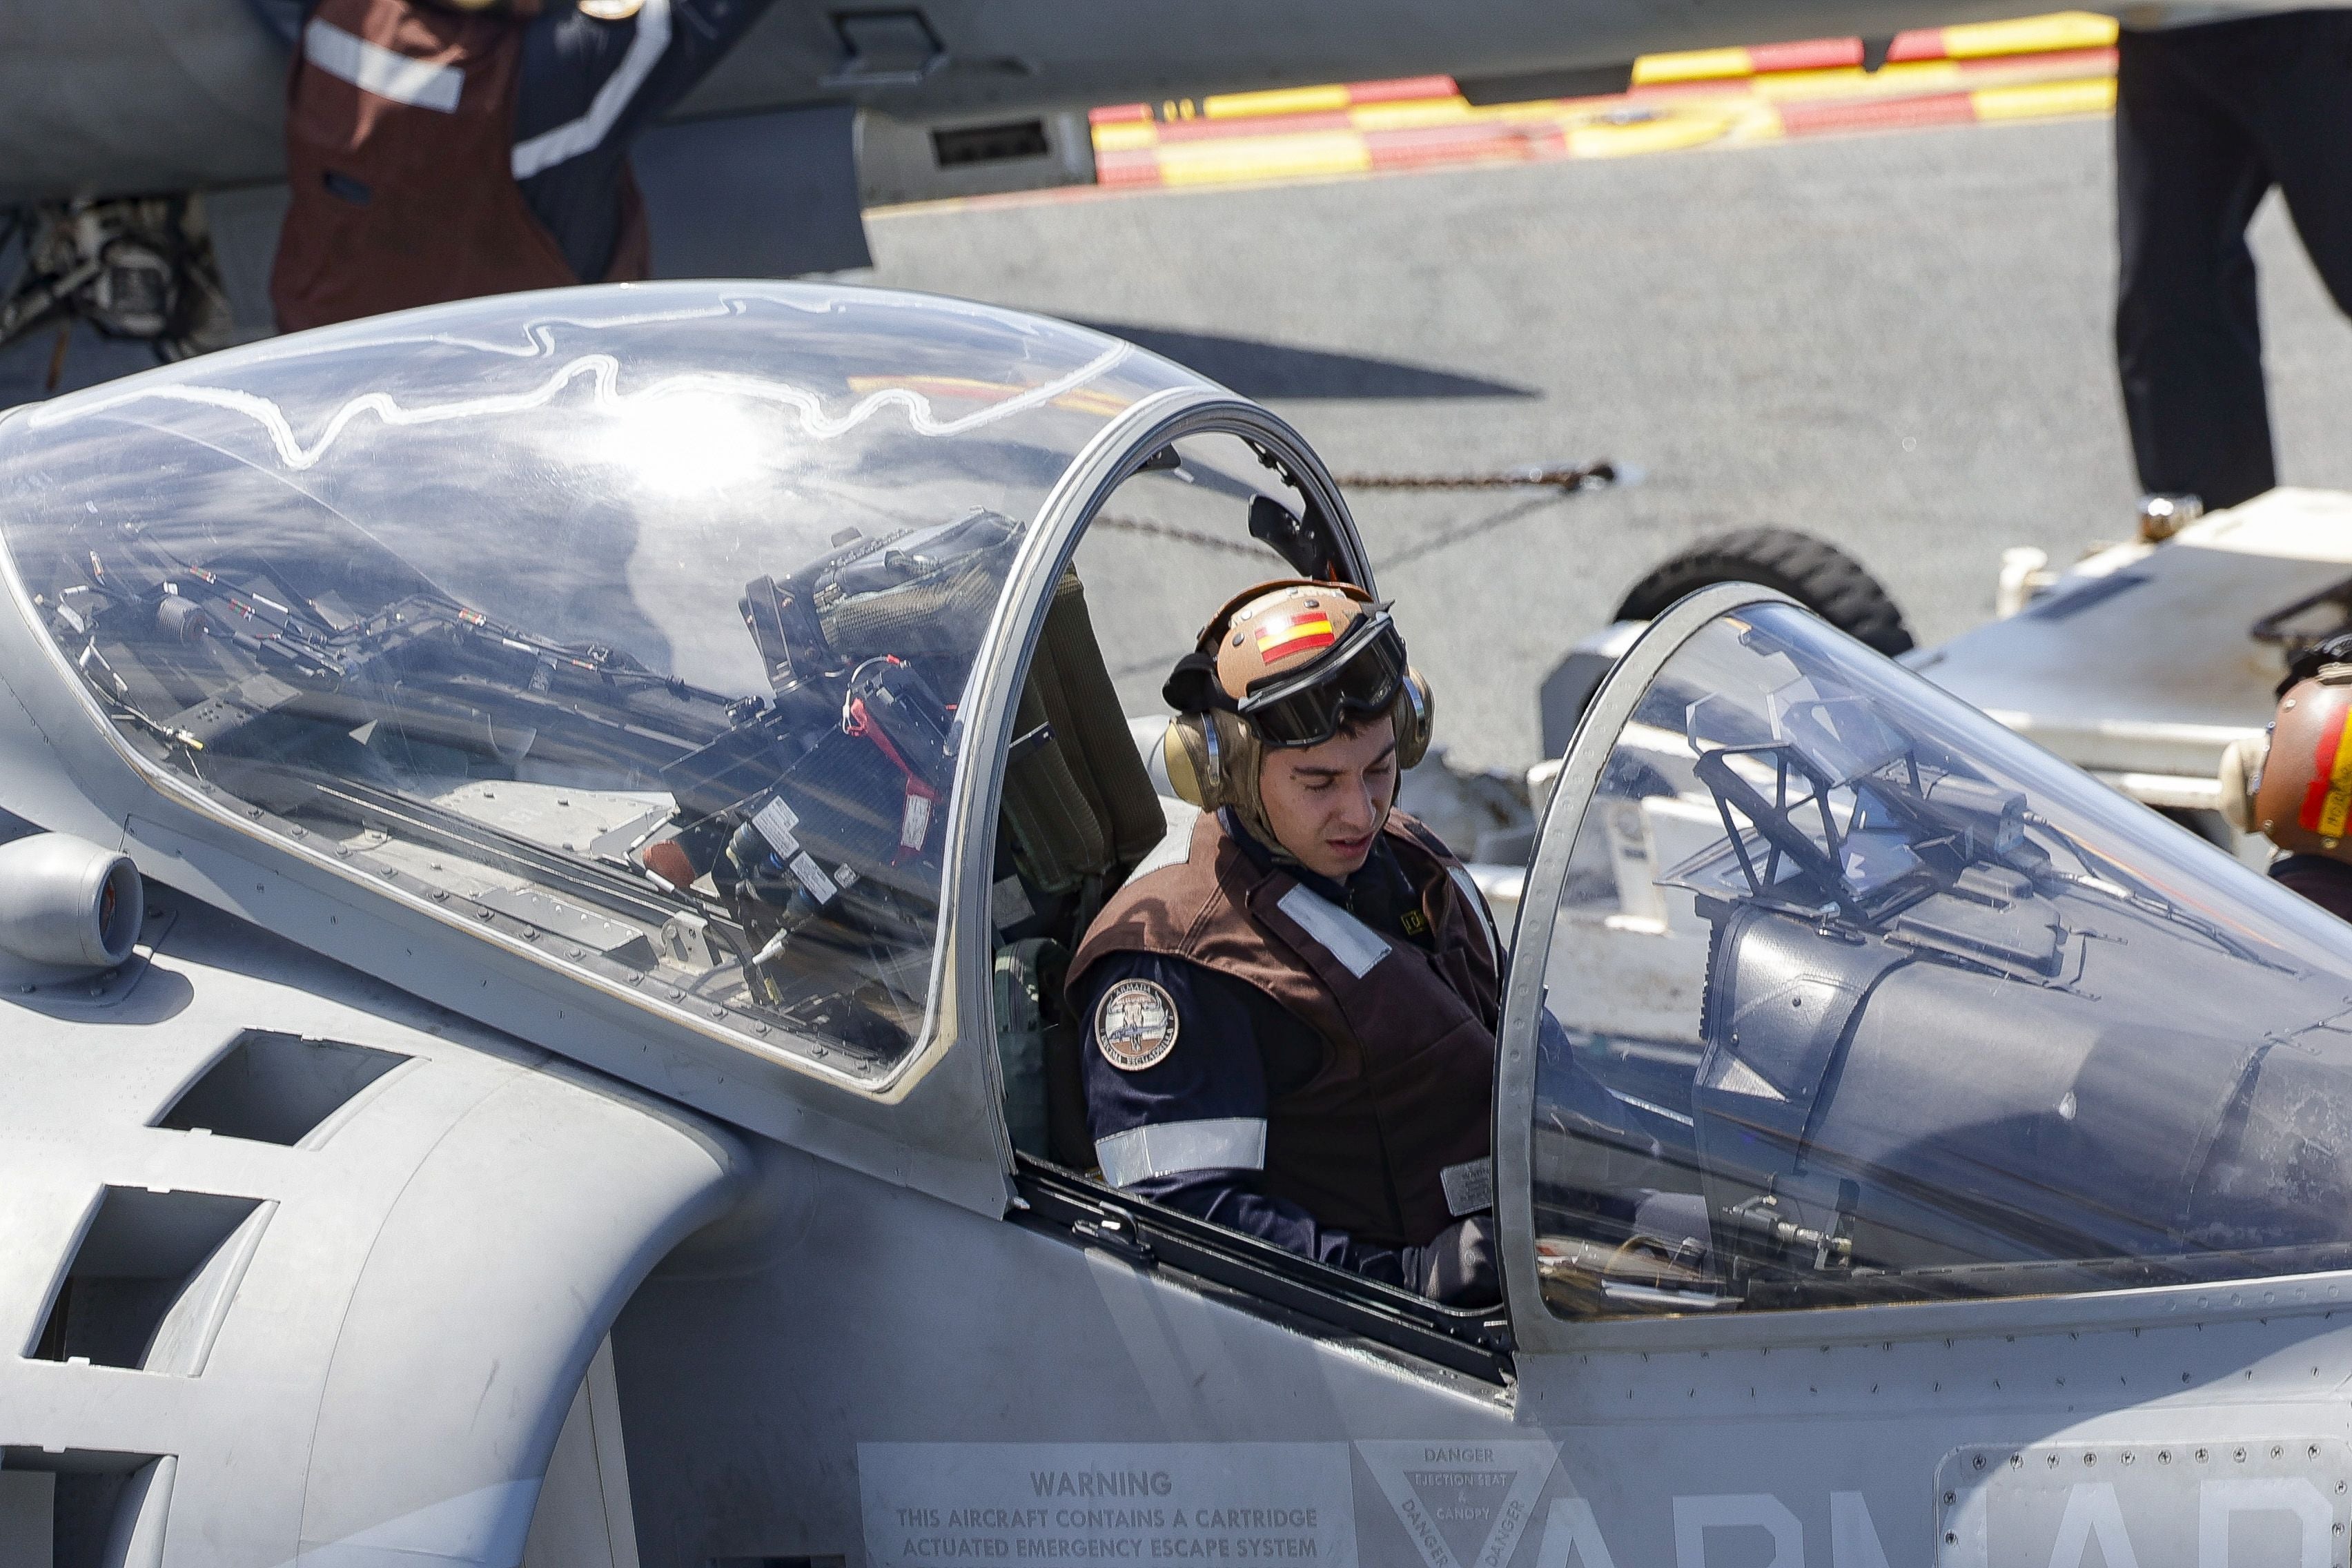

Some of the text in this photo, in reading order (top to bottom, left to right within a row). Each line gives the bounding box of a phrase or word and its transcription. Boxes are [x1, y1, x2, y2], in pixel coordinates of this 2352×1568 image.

[1424, 1447, 1494, 1463] DANGER
[1030, 1470, 1173, 1498] WARNING
[1415, 1473, 1508, 1487] EJECTION SEAT
[896, 1508, 1317, 1528] THIS AIRCRAFT CONTAINS A CARTRIDGE
[1435, 1507, 1491, 1520] CANOPY
[1401, 1499, 1449, 1568] DANGER
[1484, 1500, 1525, 1567] DANGER
[903, 1537, 1317, 1558] ACTUATED EMERGENCY ESCAPE SYSTEM
